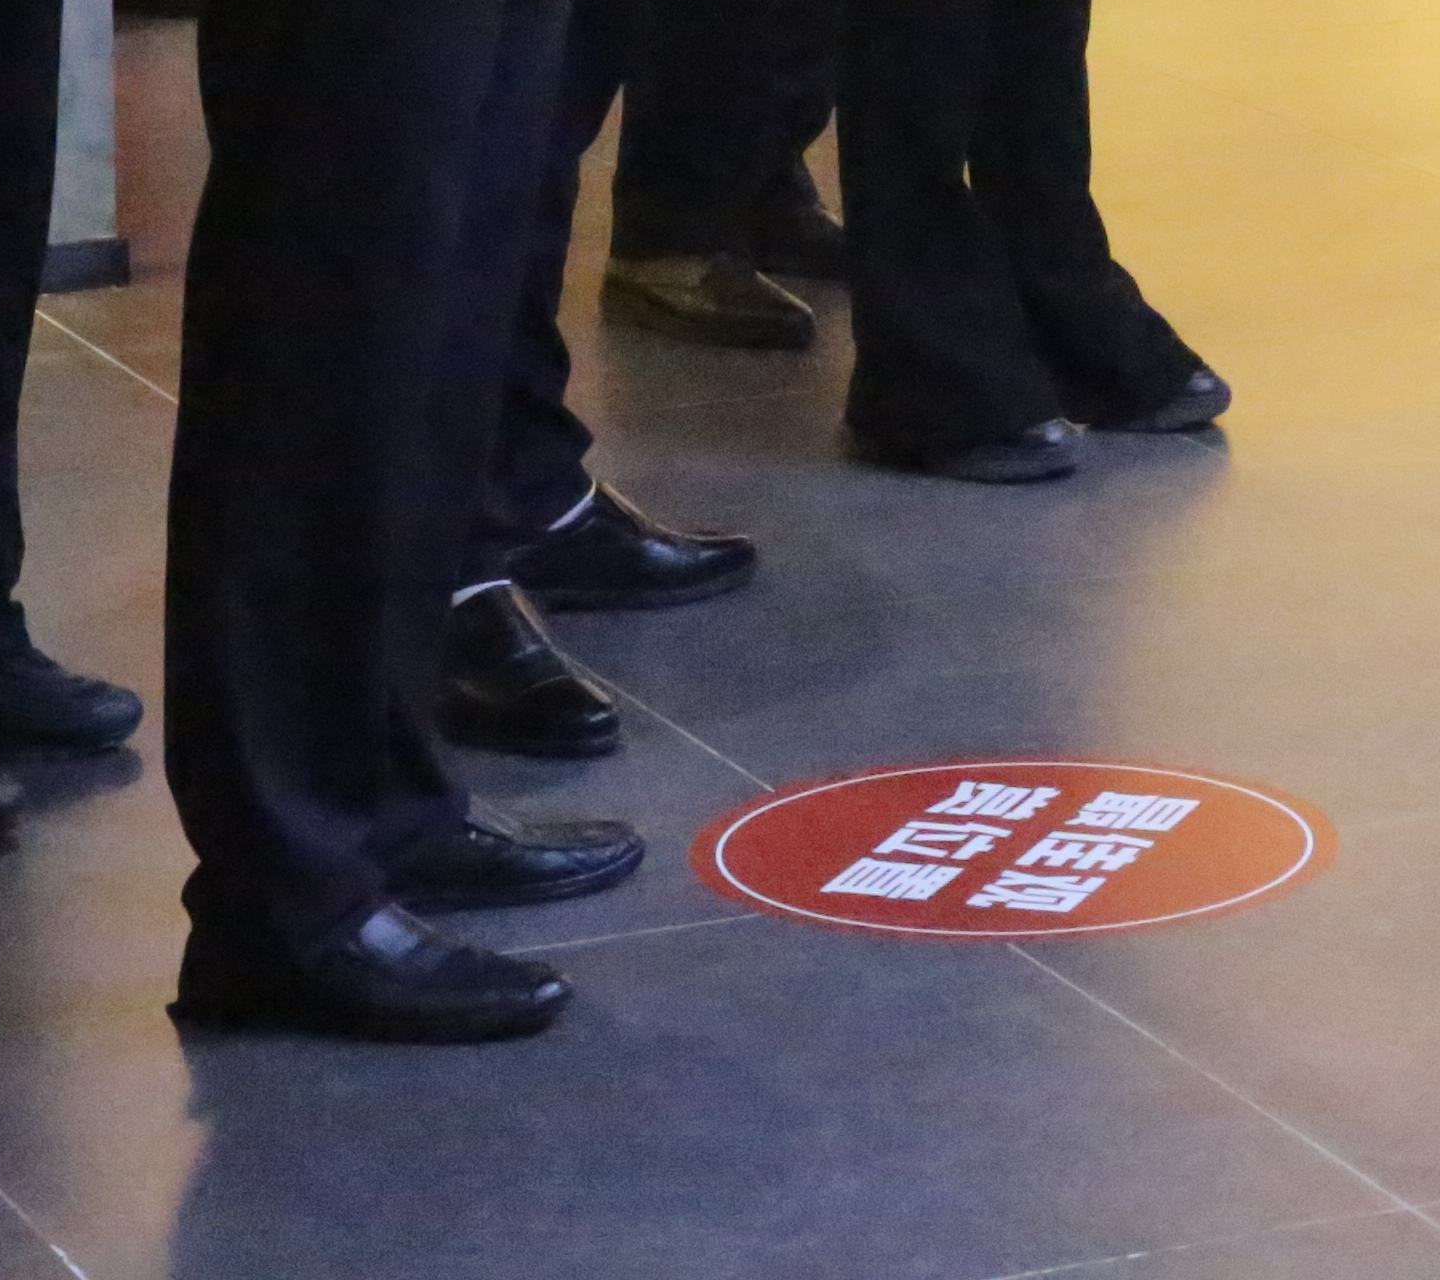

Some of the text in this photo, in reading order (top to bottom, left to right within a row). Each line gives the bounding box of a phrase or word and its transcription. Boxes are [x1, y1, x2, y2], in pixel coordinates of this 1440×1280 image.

[819, 780, 1061, 901] 赏位置
[966, 790, 1201, 914] 最佳观
